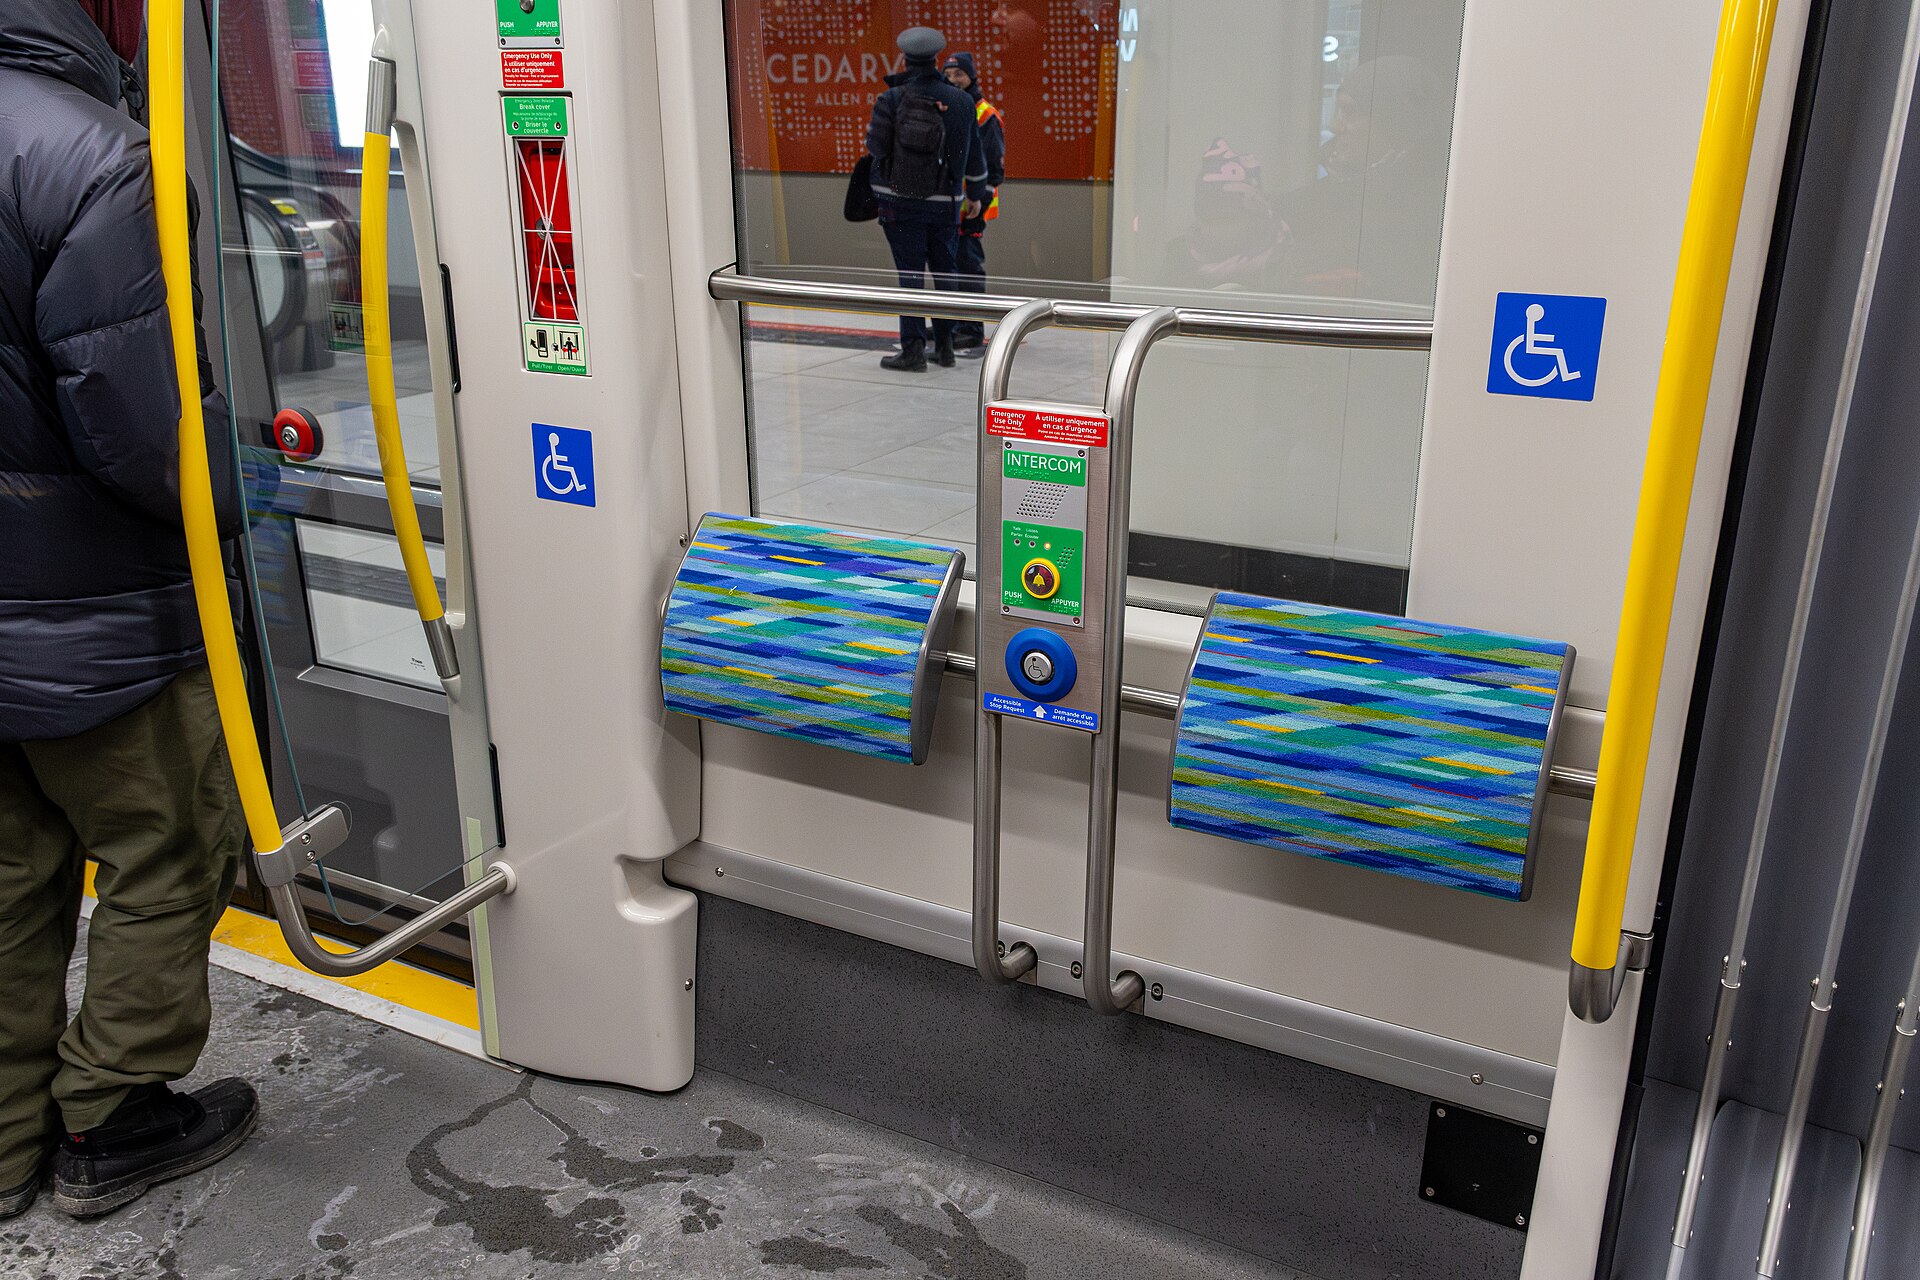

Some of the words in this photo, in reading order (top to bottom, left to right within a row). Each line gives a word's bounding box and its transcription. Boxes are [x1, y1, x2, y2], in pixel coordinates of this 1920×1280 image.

[815, 93, 860, 106] ALLEN
[991, 410, 1026, 420] Emergency
[1007, 419, 1023, 427] Only
[1041, 415, 1065, 423] utiliser
[1065, 418, 1105, 428] uniquement
[1064, 424, 1097, 435] d'urgence
[1007, 452, 1081, 474] INTERCOM
[1004, 590, 1023, 599] PUSH
[1051, 598, 1079, 608] APPUYER
[989, 701, 1002, 709] Stop
[1002, 704, 1025, 714] Request
[992, 696, 1022, 707] Accessible
[1051, 714, 1066, 722] arrêt
[1066, 717, 1095, 727] accessible
[1053, 708, 1080, 719] Demande
[1080, 712, 1093, 721] d'un
